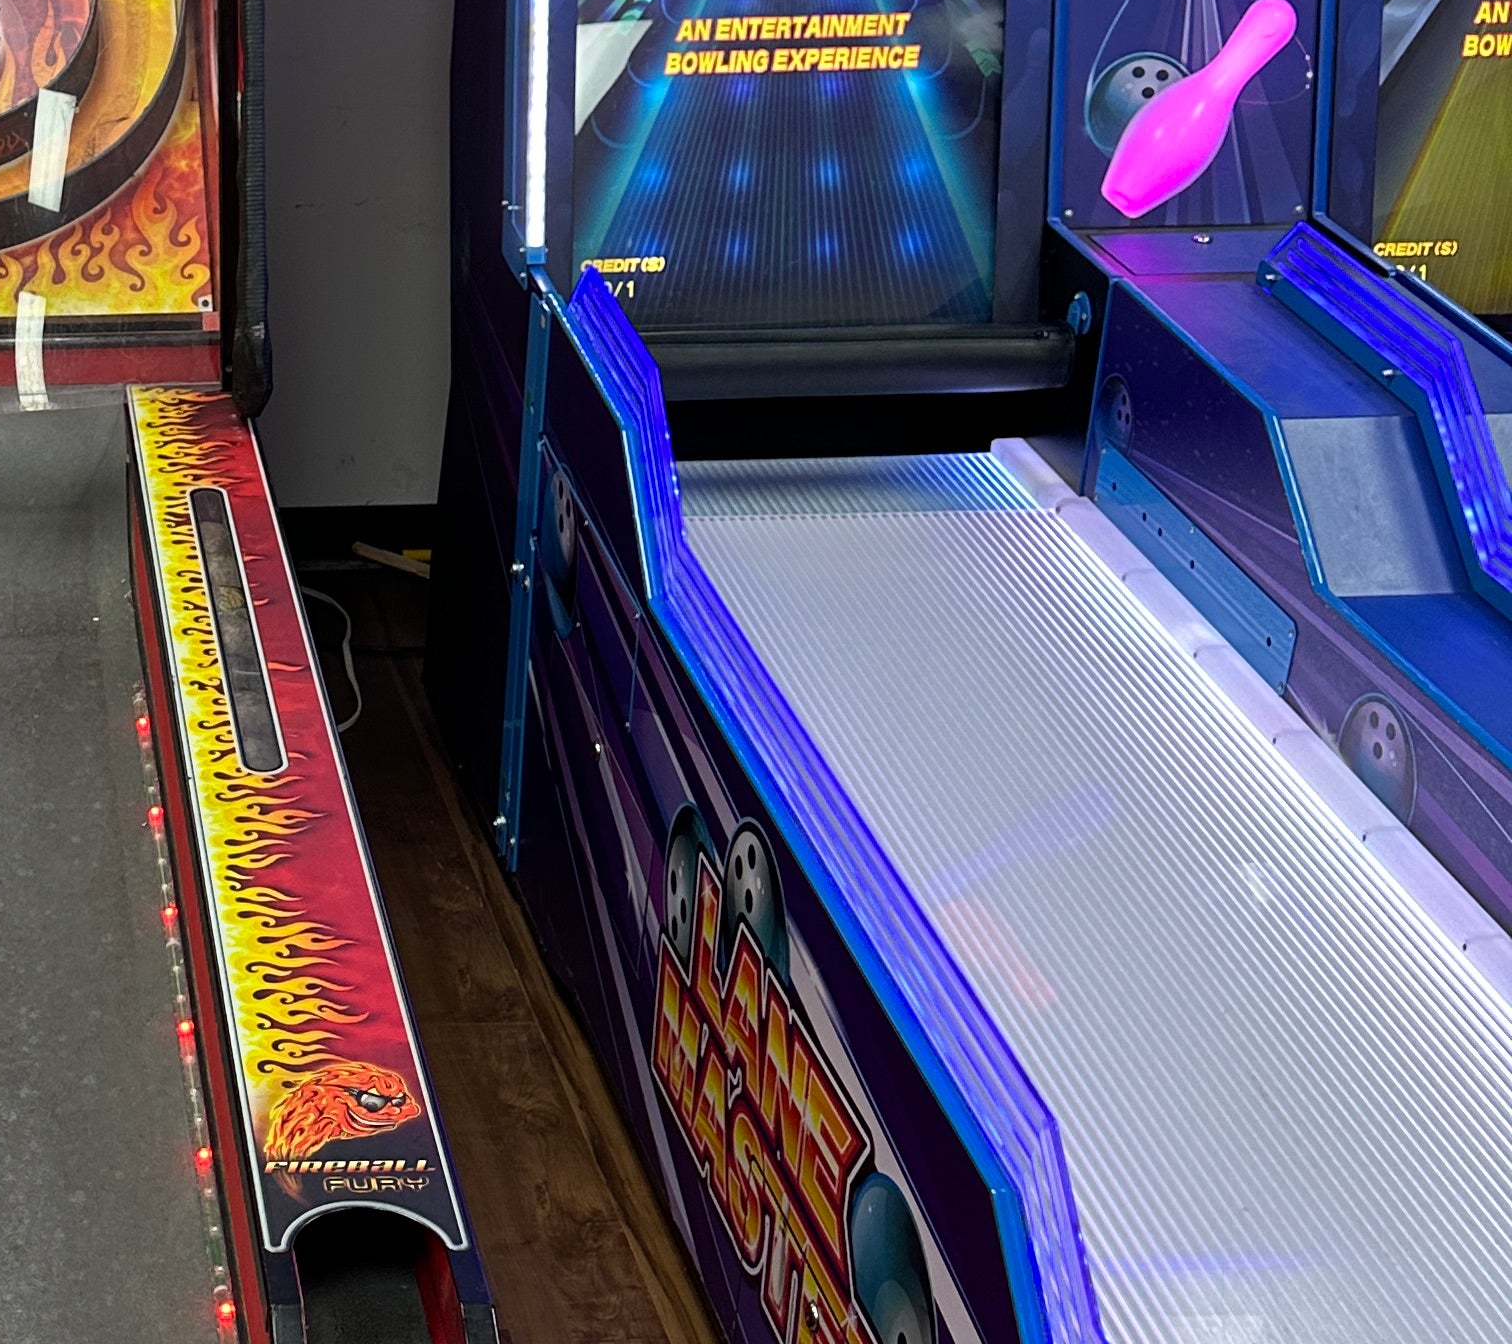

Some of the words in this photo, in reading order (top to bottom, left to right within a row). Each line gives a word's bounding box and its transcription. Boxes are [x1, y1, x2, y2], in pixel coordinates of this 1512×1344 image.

[676, 19, 712, 43] AN
[715, 11, 911, 42] ENTERTAINMENT
[665, 47, 769, 75] BOWLING
[772, 42, 921, 72] EXPERIENCE
[323, 1176, 430, 1193] FURY
